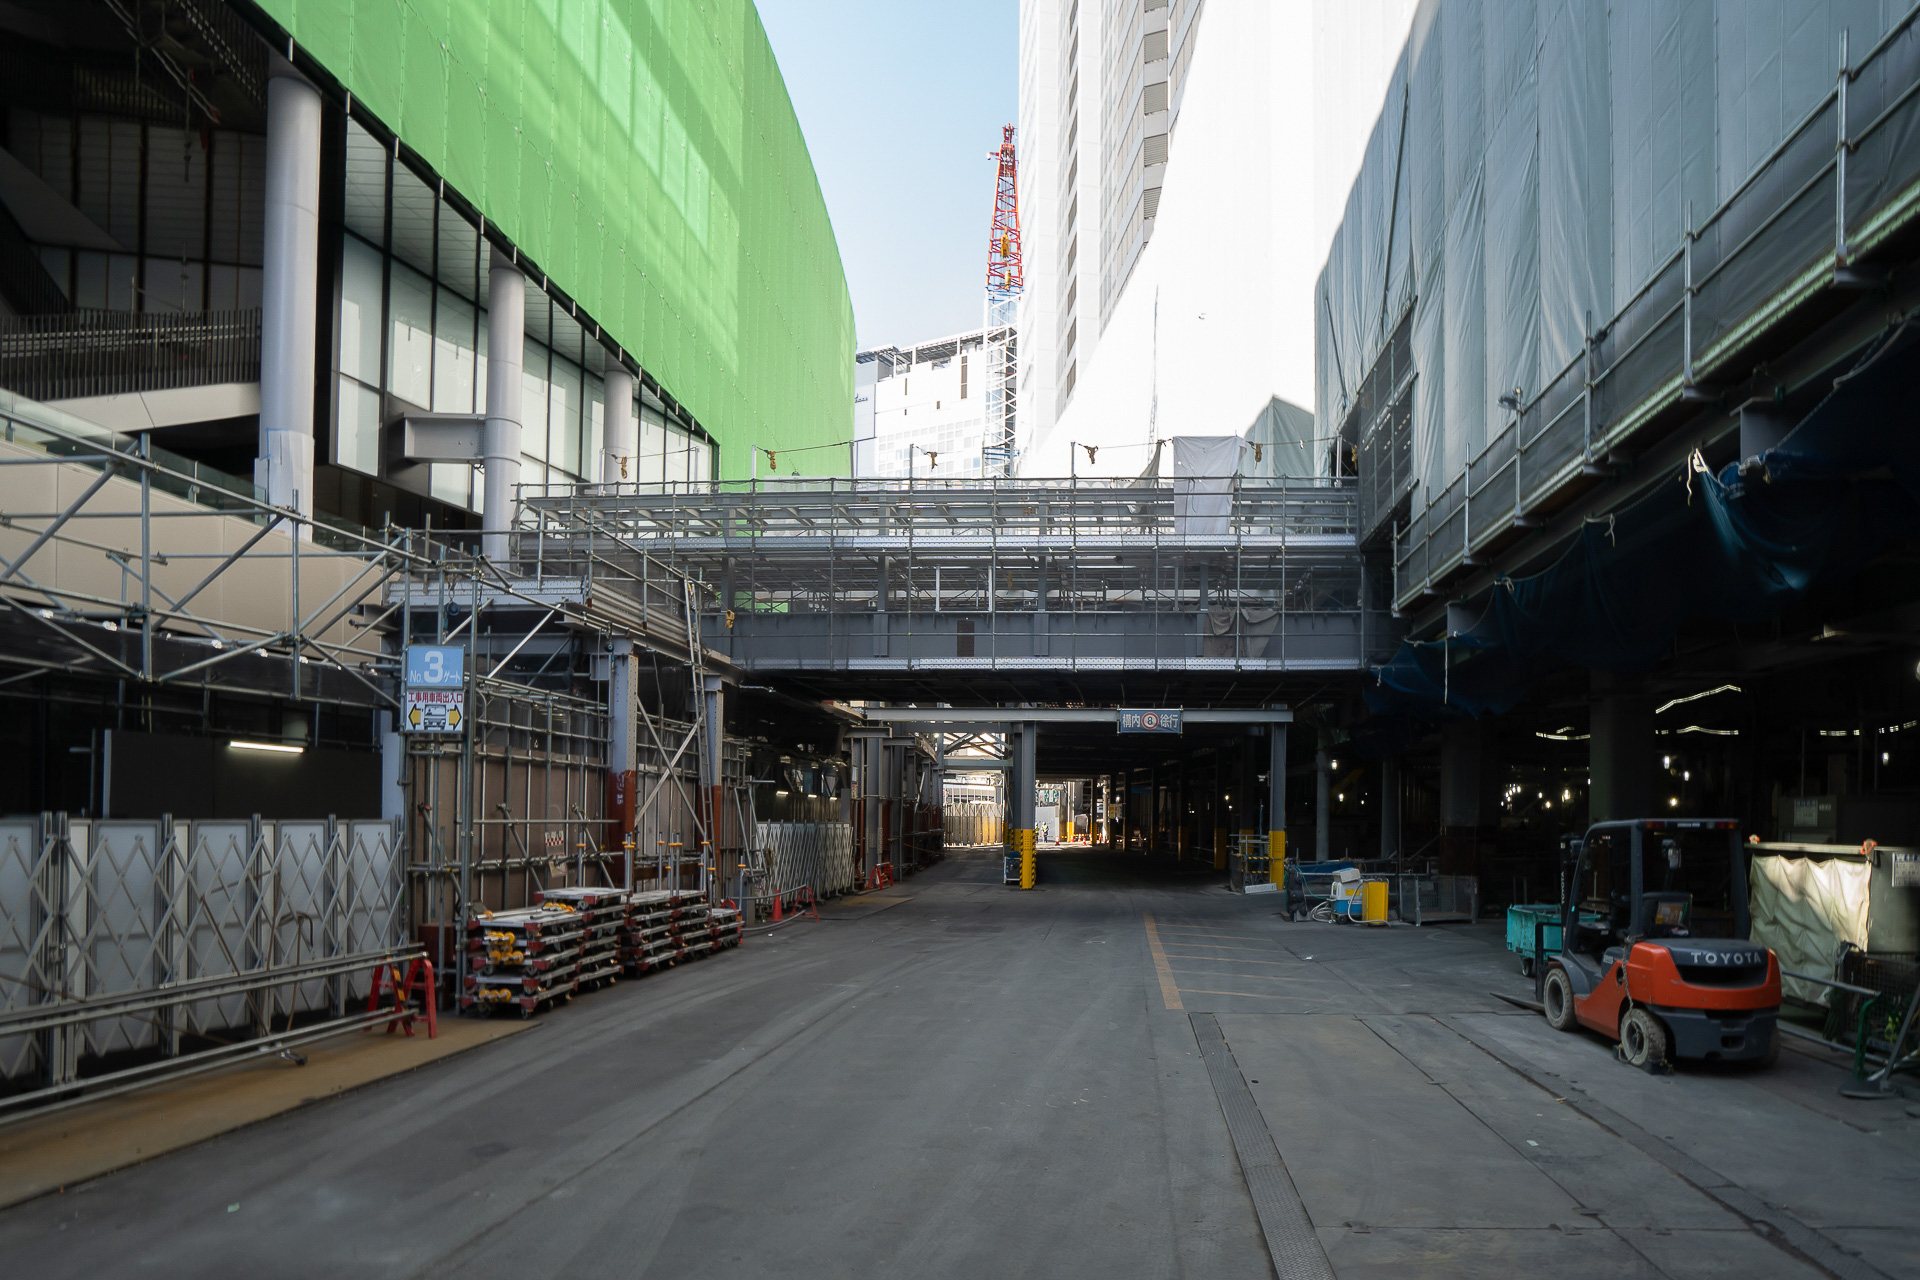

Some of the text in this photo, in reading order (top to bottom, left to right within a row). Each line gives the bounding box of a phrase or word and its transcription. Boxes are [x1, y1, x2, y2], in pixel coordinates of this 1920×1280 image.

[408, 691, 463, 703] 工事用車両出入口
[1691, 952, 1762, 965] TOYOTA
